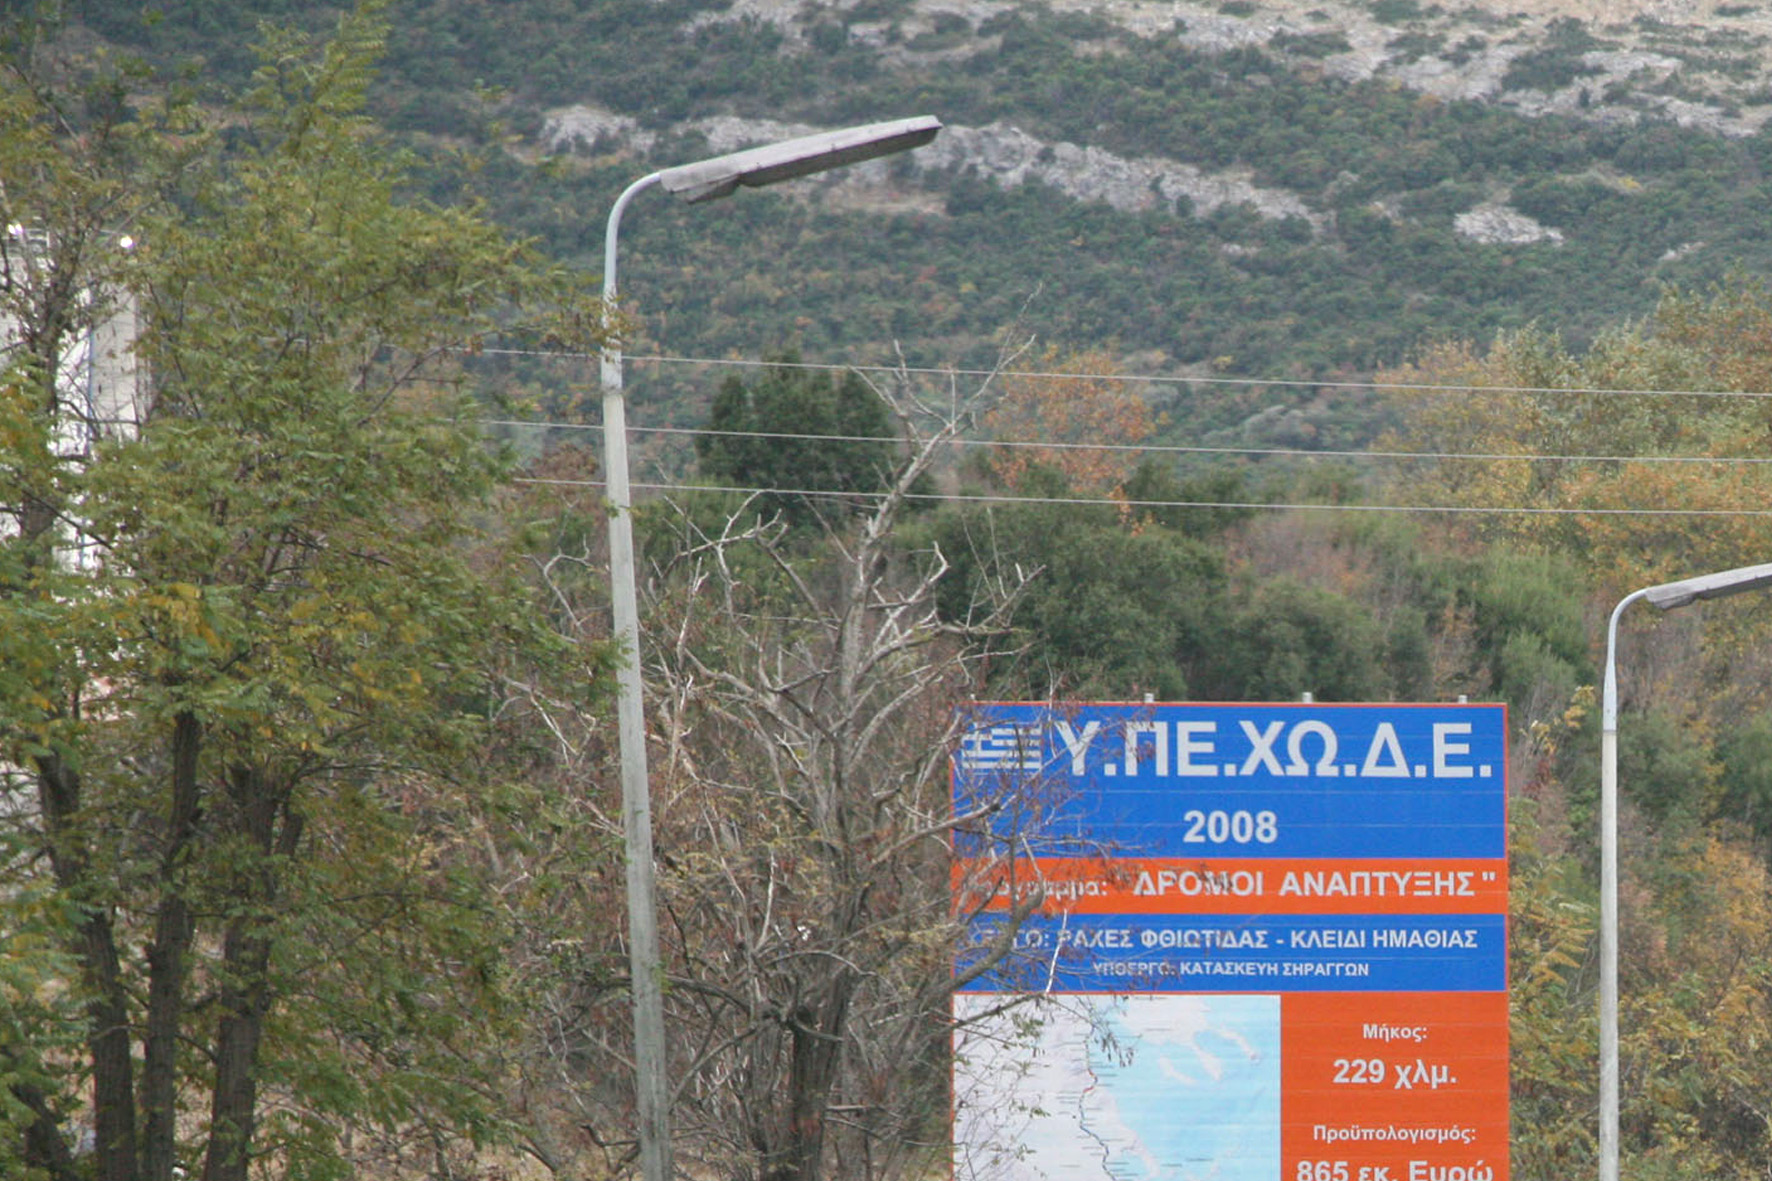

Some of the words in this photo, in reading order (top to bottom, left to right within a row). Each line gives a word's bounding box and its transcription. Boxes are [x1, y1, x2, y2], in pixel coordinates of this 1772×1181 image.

[1183, 810, 1278, 844] 2008
[1058, 929, 1133, 948] ΡΑΧΕΣ
[1140, 929, 1268, 949] ΦΘΙΩΤΙΔΑΣ
[1291, 929, 1366, 948] ΚΛΕΙΔΙ
[1372, 929, 1478, 948] ΗΜΑΘΙΑΣ
[1180, 961, 1278, 976] ΚΑΤΑΣΚΕΥΗ
[1282, 962, 1370, 976] ΣΗΡΑΓΓΩΝ
[1363, 1024, 1427, 1042] Μήκος:
[1333, 1059, 1385, 1083] 229
[1394, 1059, 1457, 1089] χλμ.
[1313, 1125, 1476, 1143] Προϋπολογισμός:
